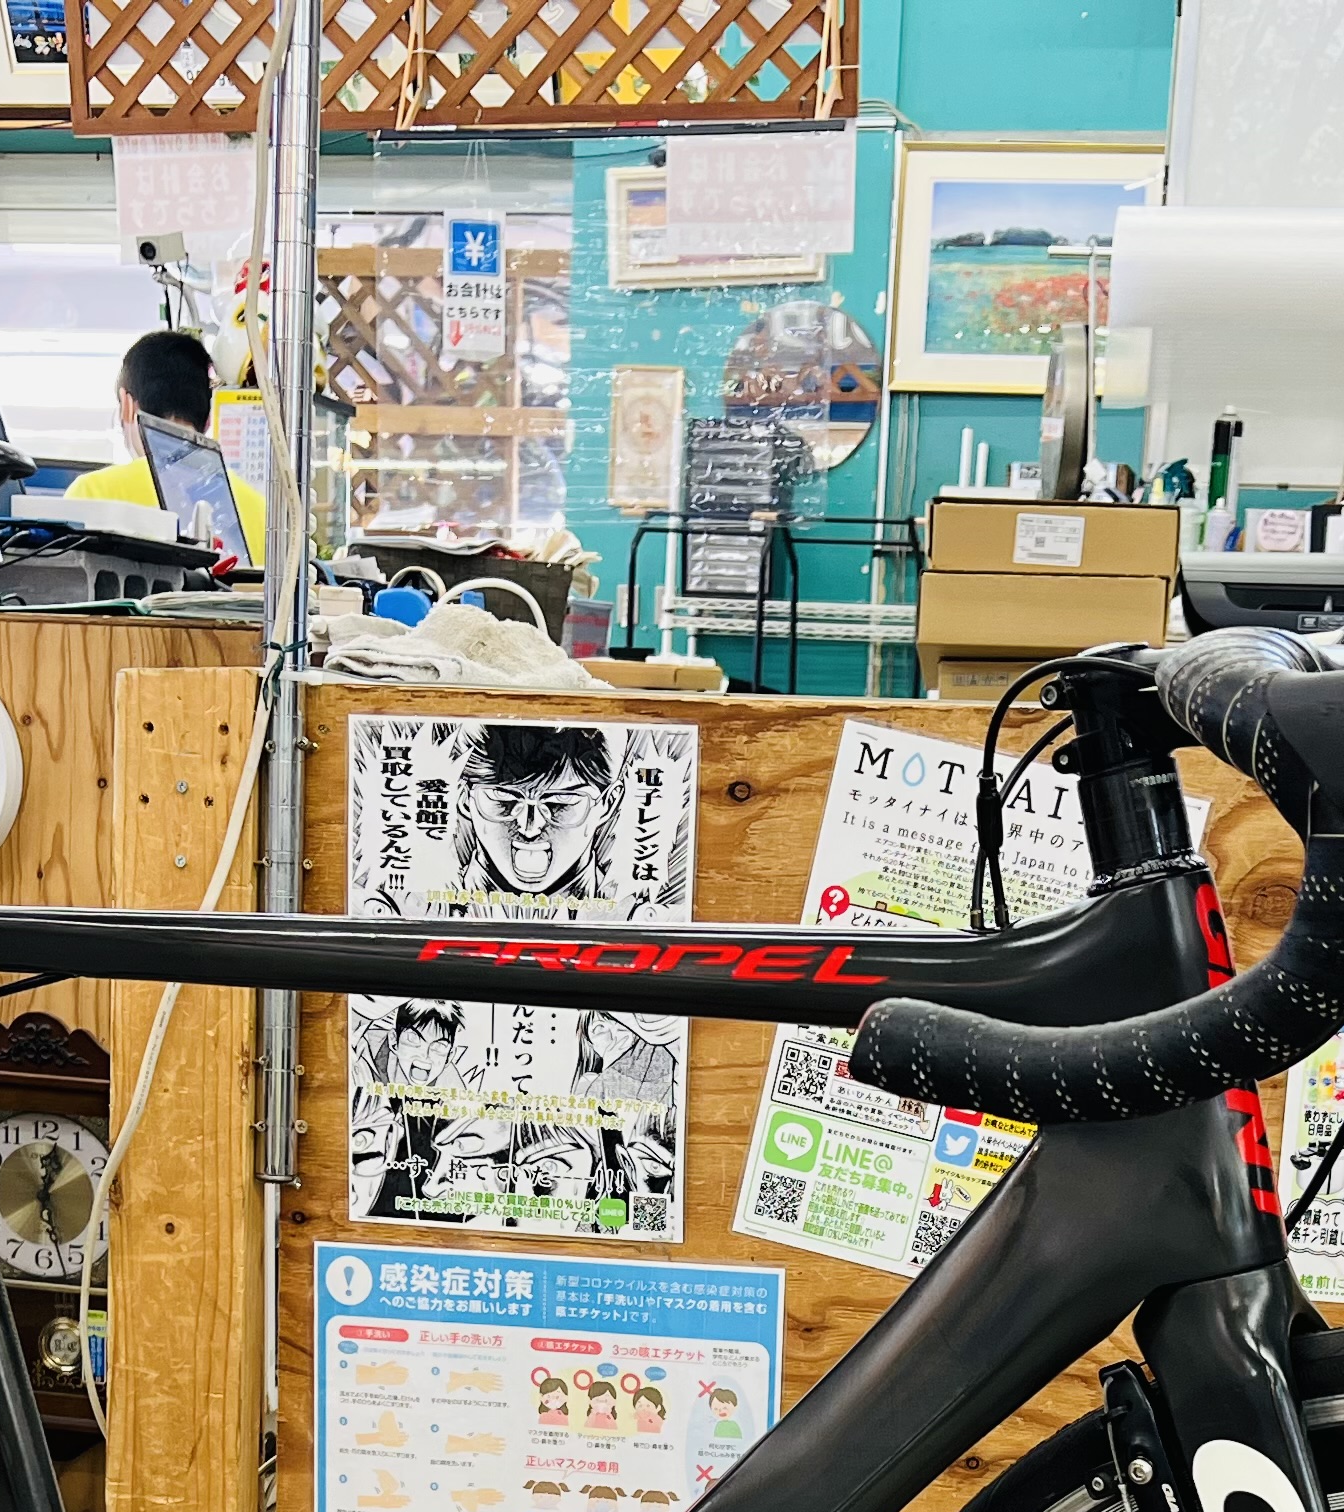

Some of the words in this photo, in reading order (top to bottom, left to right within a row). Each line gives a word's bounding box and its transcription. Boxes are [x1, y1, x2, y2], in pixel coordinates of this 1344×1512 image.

[446, 282, 503, 298] お会計は
[446, 306, 503, 320] こちらです
[415, 777, 450, 841] 愛品館で
[632, 767, 663, 882] 電子レンジは
[843, 811, 856, 826] It
[862, 816, 876, 831] is
[882, 823, 890, 835] a
[897, 827, 963, 851] message
[1012, 850, 1056, 873] Japan
[1063, 864, 1078, 878] to
[416, 938, 891, 987] PROPEL
[2, 1126, 22, 1147] 11
[33, 1120, 59, 1141] 12
[72, 1131, 84, 1151] 1
[780, 1131, 808, 1148] LINE
[90, 1157, 107, 1178] 2
[821, 1139, 894, 1174] LINE@
[6, 1238, 24, 1260] 7
[35, 1248, 53, 1270] 6
[68, 1244, 84, 1266] 5
[379, 1263, 534, 1301] 感染症対策
[555, 1274, 768, 1298] 新型コロナウイルスを含む感染症対策の
[379, 1295, 533, 1317] へのご協力をお願いします
[419, 1330, 504, 1347] 正しい手の洗い方
[612, 1344, 705, 1362] 3つの咳エチケット
[525, 1454, 620, 1474] 正しいマスクの着用
